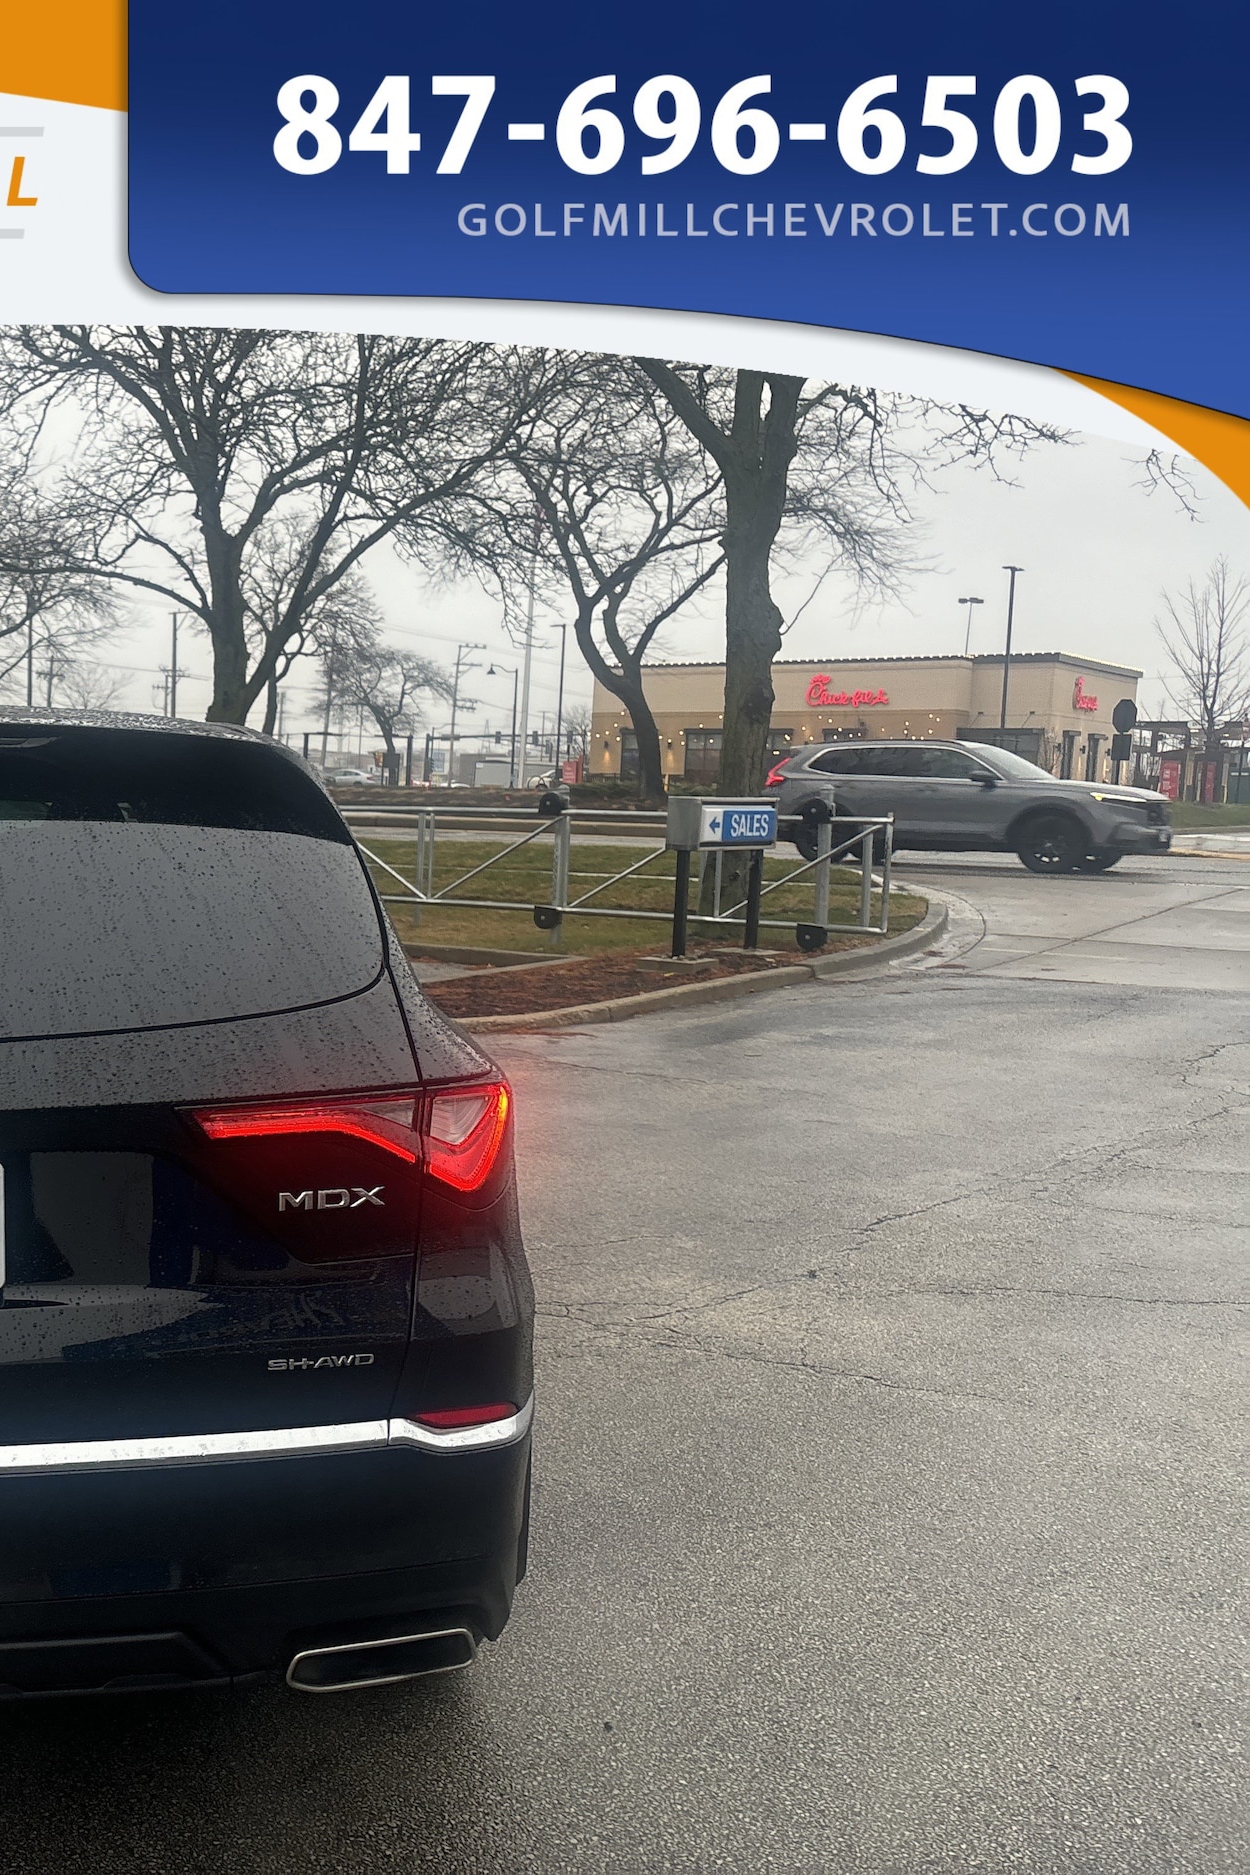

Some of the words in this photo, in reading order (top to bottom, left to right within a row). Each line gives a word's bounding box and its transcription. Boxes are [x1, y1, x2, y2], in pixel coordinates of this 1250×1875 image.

[730, 814, 769, 837] SALES
[278, 1186, 386, 1212] MDX
[267, 1353, 375, 1371] SH-AWD
